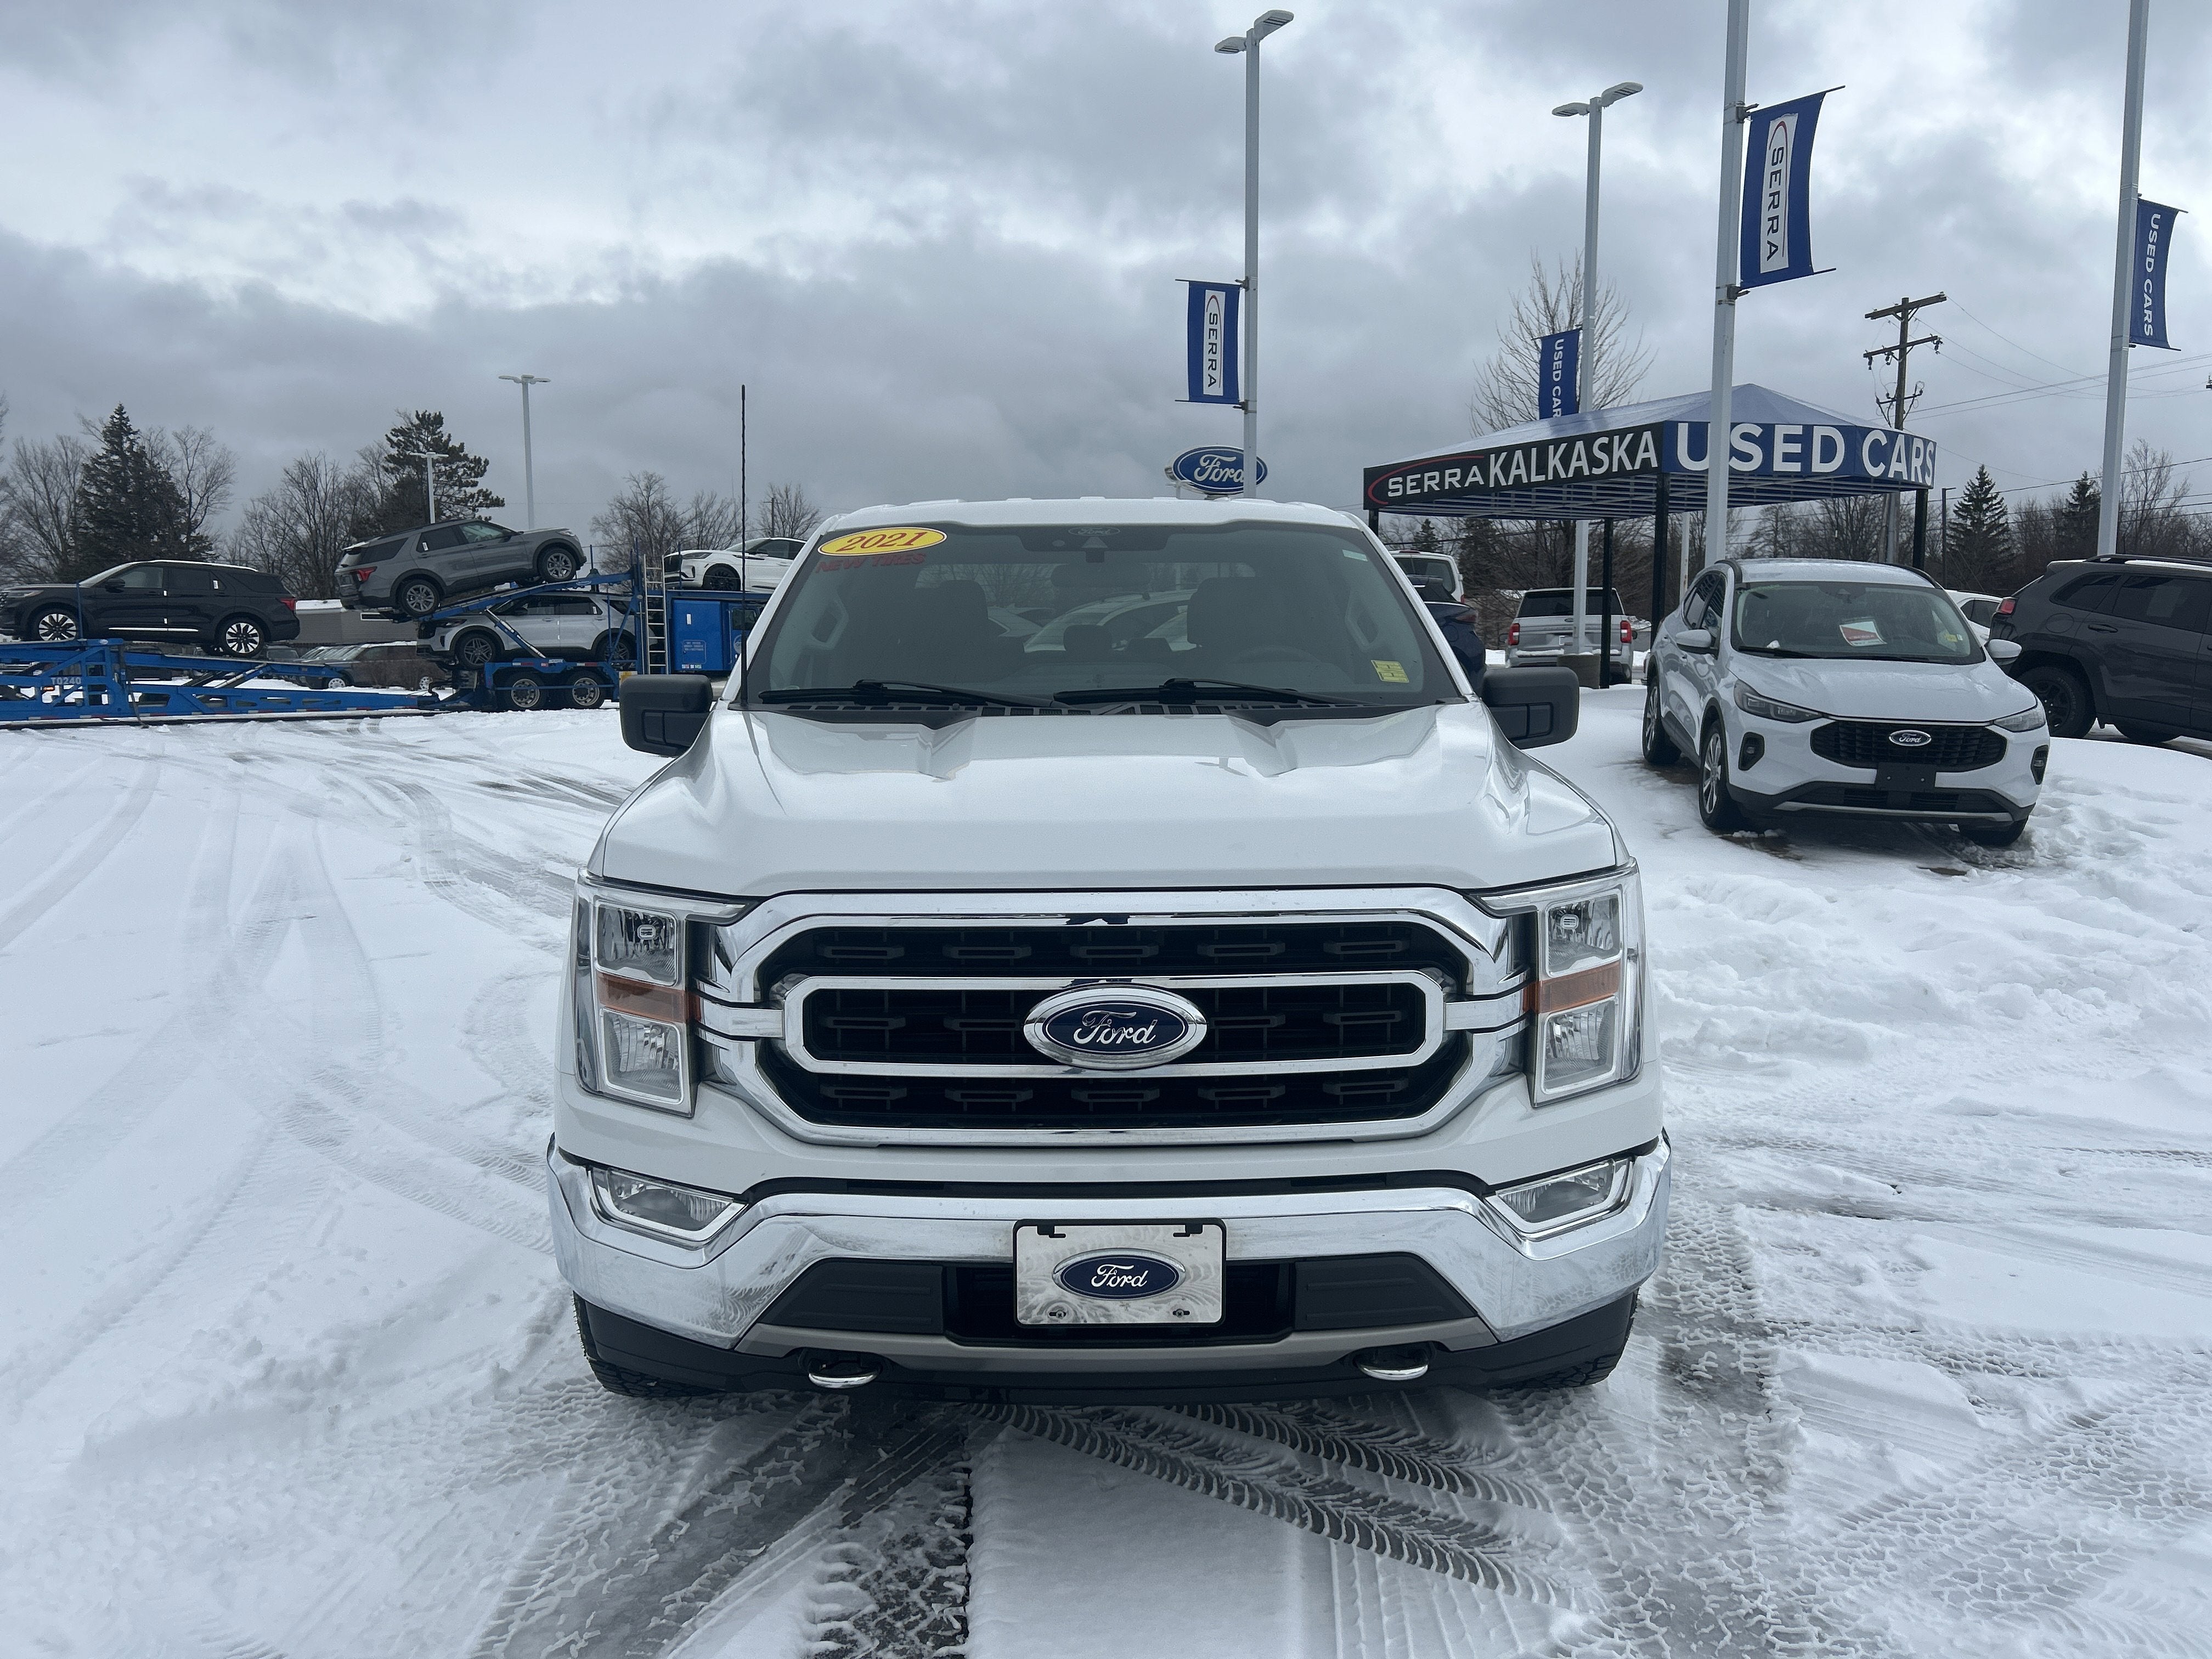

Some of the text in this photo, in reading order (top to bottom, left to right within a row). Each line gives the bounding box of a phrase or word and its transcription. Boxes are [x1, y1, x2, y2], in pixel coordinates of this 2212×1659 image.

[1767, 146, 1784, 262] SERRA
[2143, 213, 2161, 336] USED CARS
[1207, 312, 1218, 388] SERRA
[1552, 338, 1565, 418] USED CAR
[1387, 430, 1659, 497] SERRA KALKASKA
[1677, 422, 1934, 486] USED CARS
[816, 553, 927, 573] NEW TIRES
[835, 532, 928, 552] 2021
[1899, 733, 1922, 743] Ford
[1073, 1010, 1158, 1044] Ford
[1091, 1264, 1149, 1287] Ford
